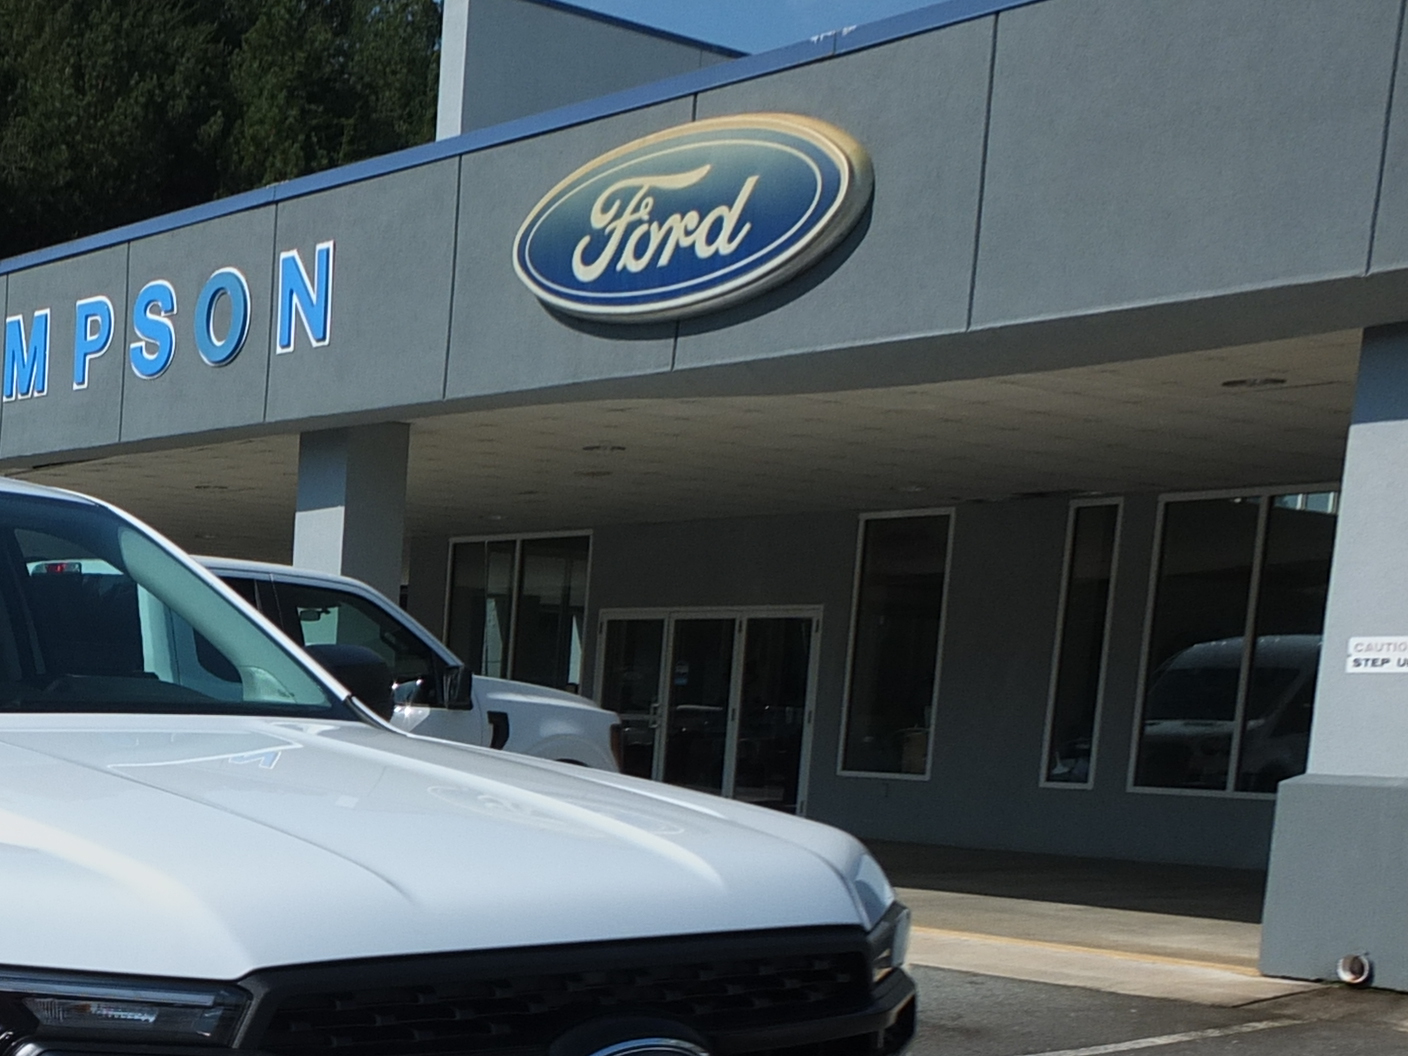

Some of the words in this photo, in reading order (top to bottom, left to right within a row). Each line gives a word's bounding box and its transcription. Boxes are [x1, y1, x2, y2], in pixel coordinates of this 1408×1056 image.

[572, 164, 759, 282] Ford
[1352, 657, 1390, 668] STEP
[1396, 657, 1408, 668] U
